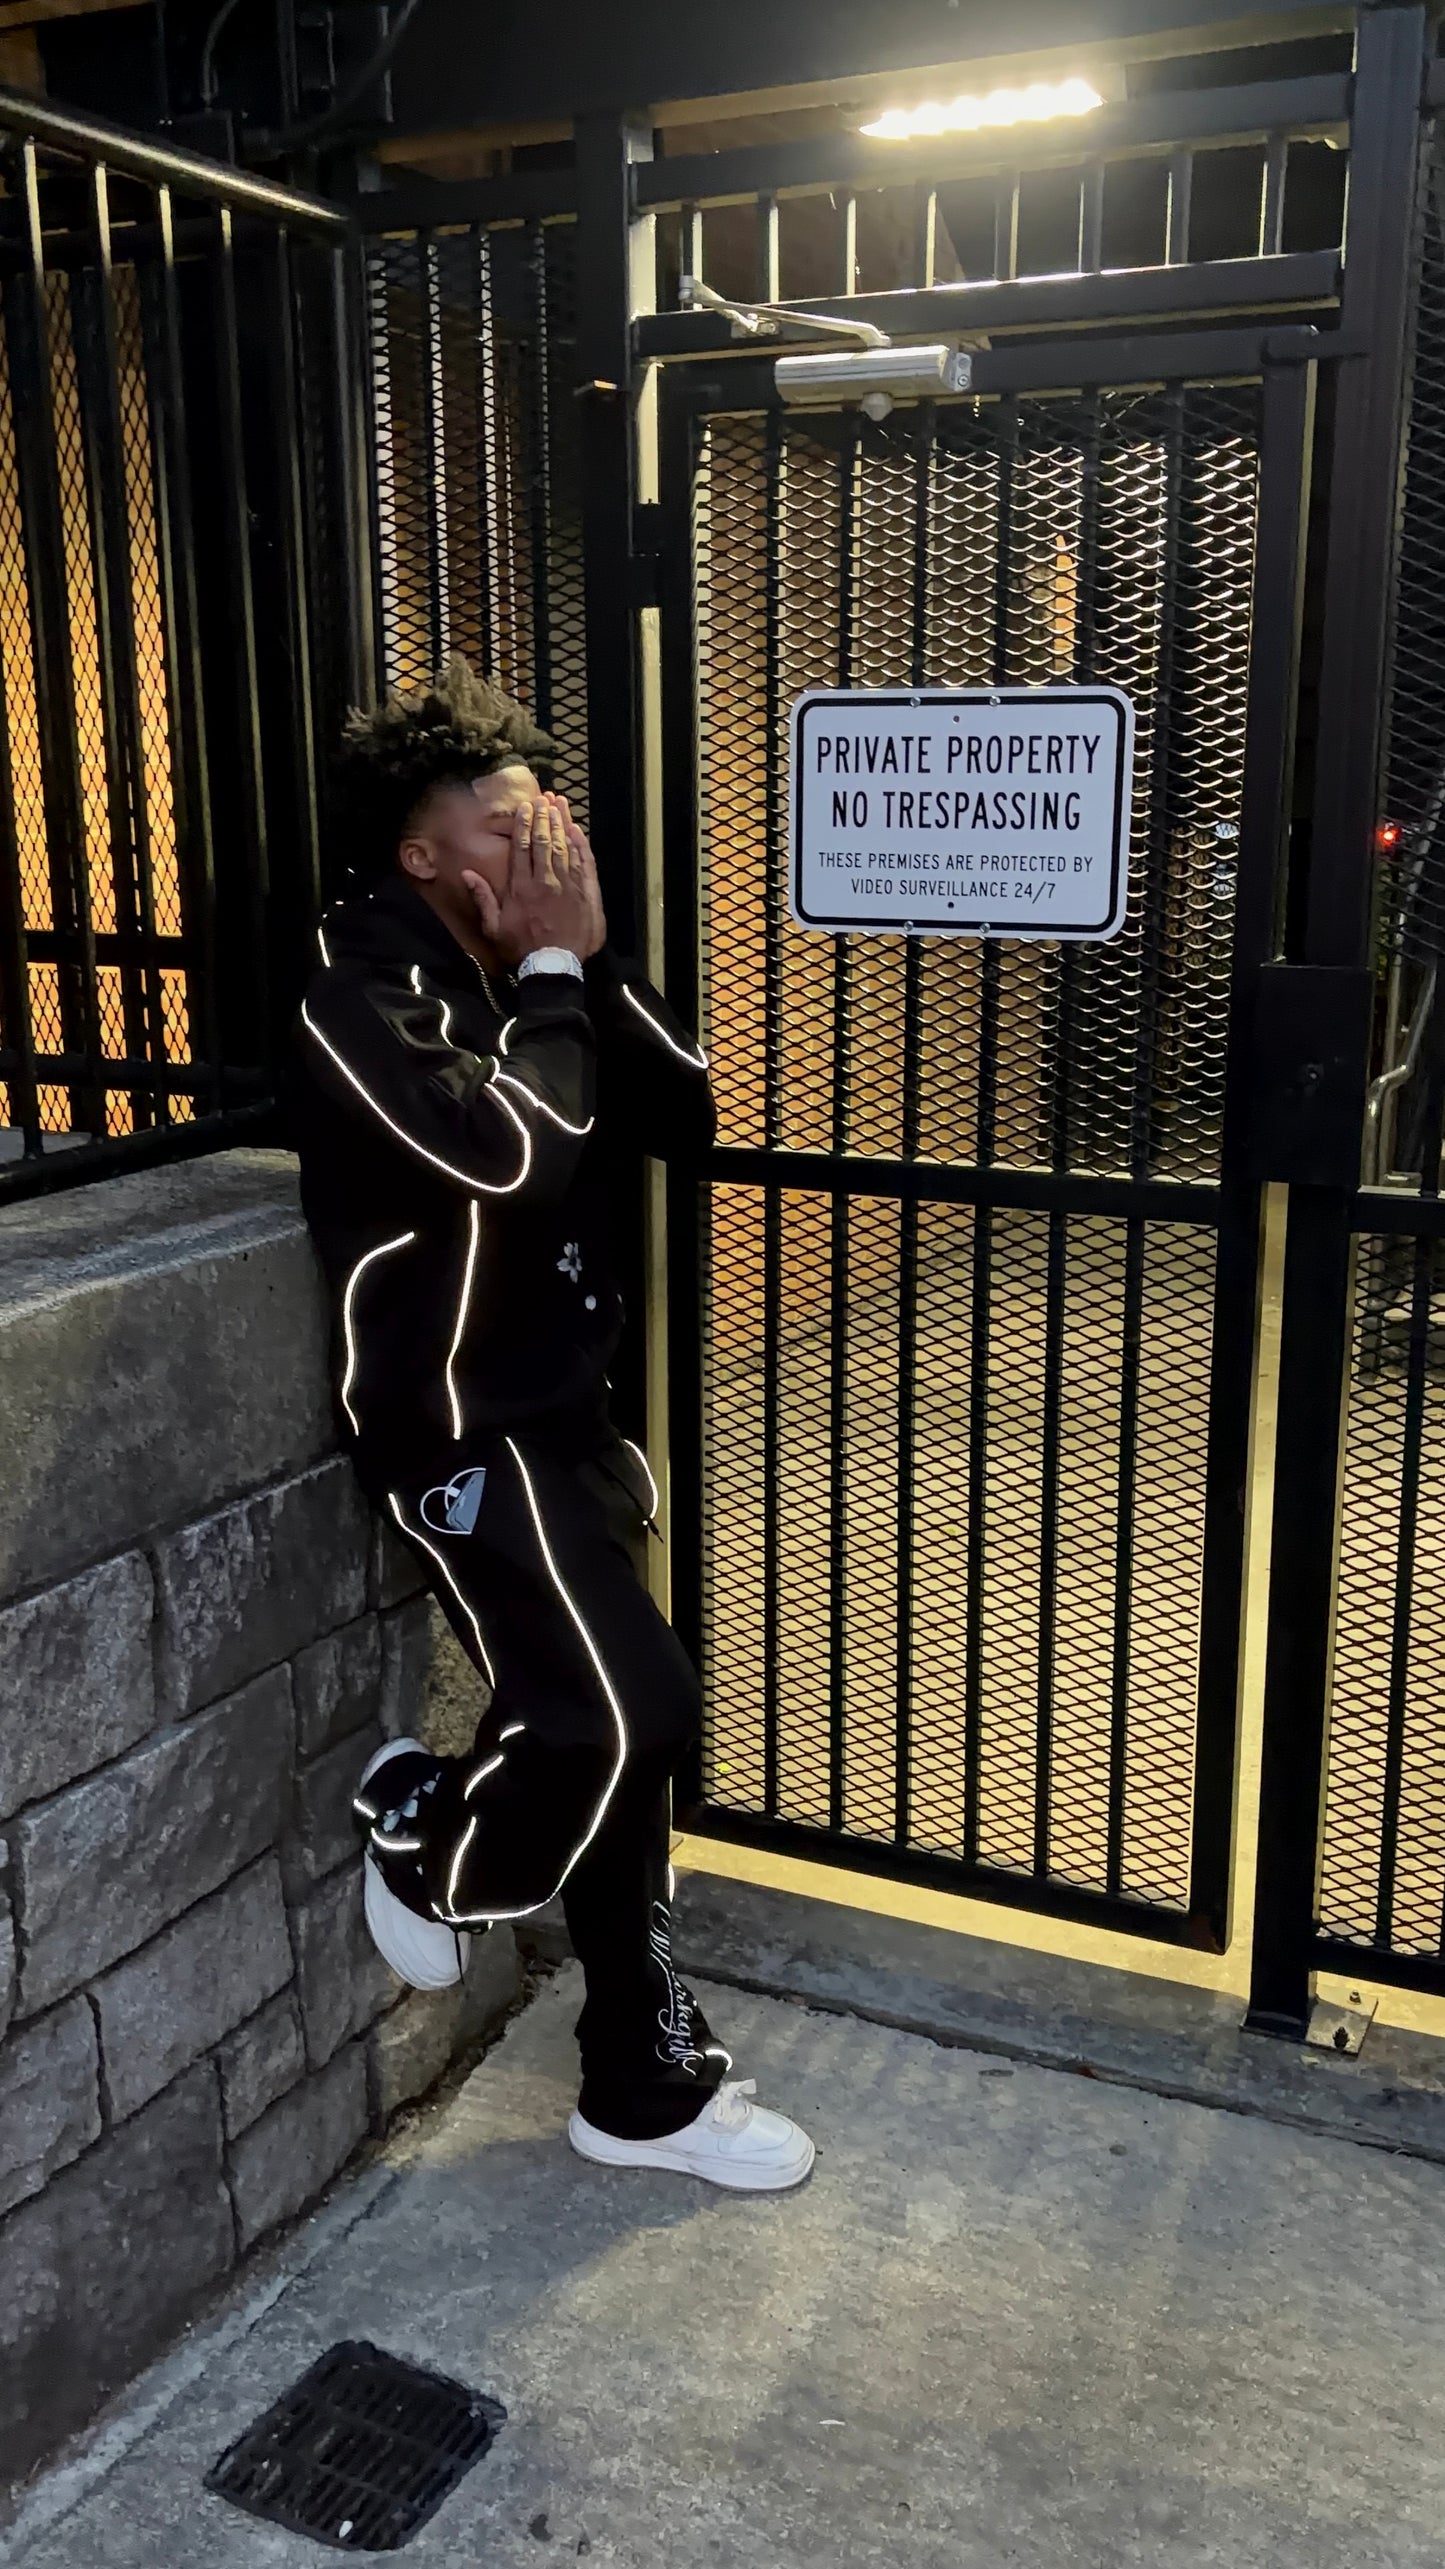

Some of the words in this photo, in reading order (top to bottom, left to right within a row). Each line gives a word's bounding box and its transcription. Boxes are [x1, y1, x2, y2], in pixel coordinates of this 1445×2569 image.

[817, 735, 932, 774] PRIVATE
[947, 734, 1101, 774] PROPERTY
[832, 790, 868, 828] NO
[882, 791, 1081, 831] TRESPASSING
[818, 851, 862, 869] THESE
[868, 852, 940, 870] PREMISES
[945, 854, 974, 871] ARE
[980, 854, 1067, 873] PROTECTED
[1073, 856, 1093, 873] BY
[851, 878, 893, 895] VIDEO
[898, 879, 1009, 898] SURVEILLANCE
[1014, 881, 1056, 904] 24/7
